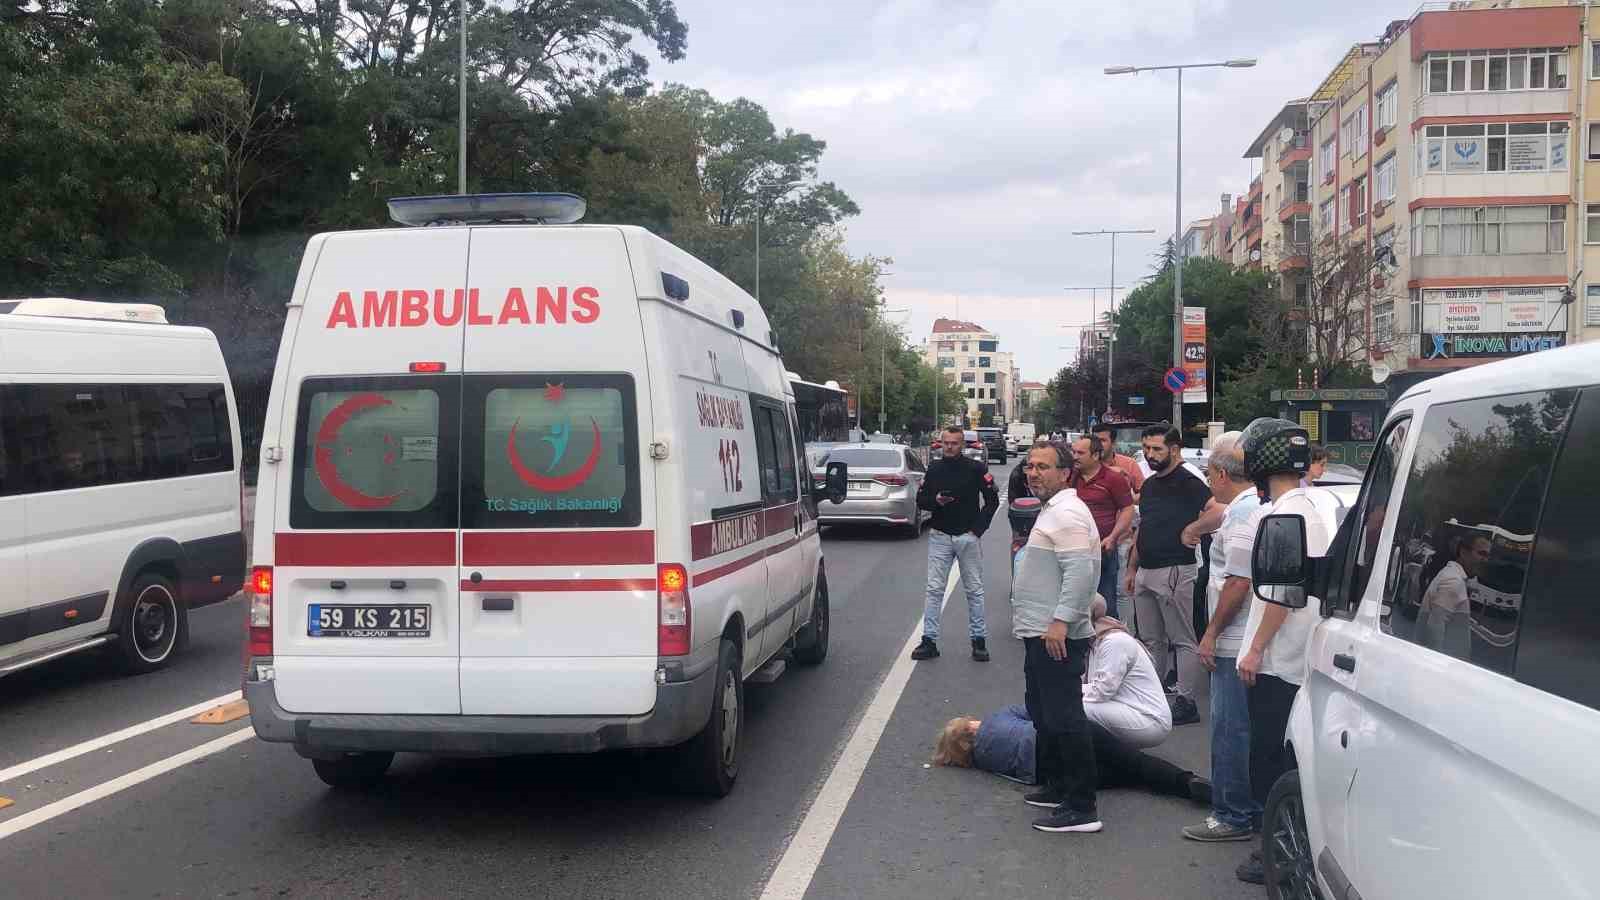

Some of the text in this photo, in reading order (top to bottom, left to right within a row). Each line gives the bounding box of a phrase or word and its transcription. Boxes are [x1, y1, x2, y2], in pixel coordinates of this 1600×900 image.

[326, 287, 600, 328] AMBULANS
[1455, 334, 1560, 353] İNOVA DİYET
[719, 439, 743, 492] 112
[510, 497, 552, 514] Sağlık
[556, 496, 622, 513] Bakanlığı
[711, 515, 759, 554] AMBULANS
[320, 608, 426, 628] 59 KS 215
